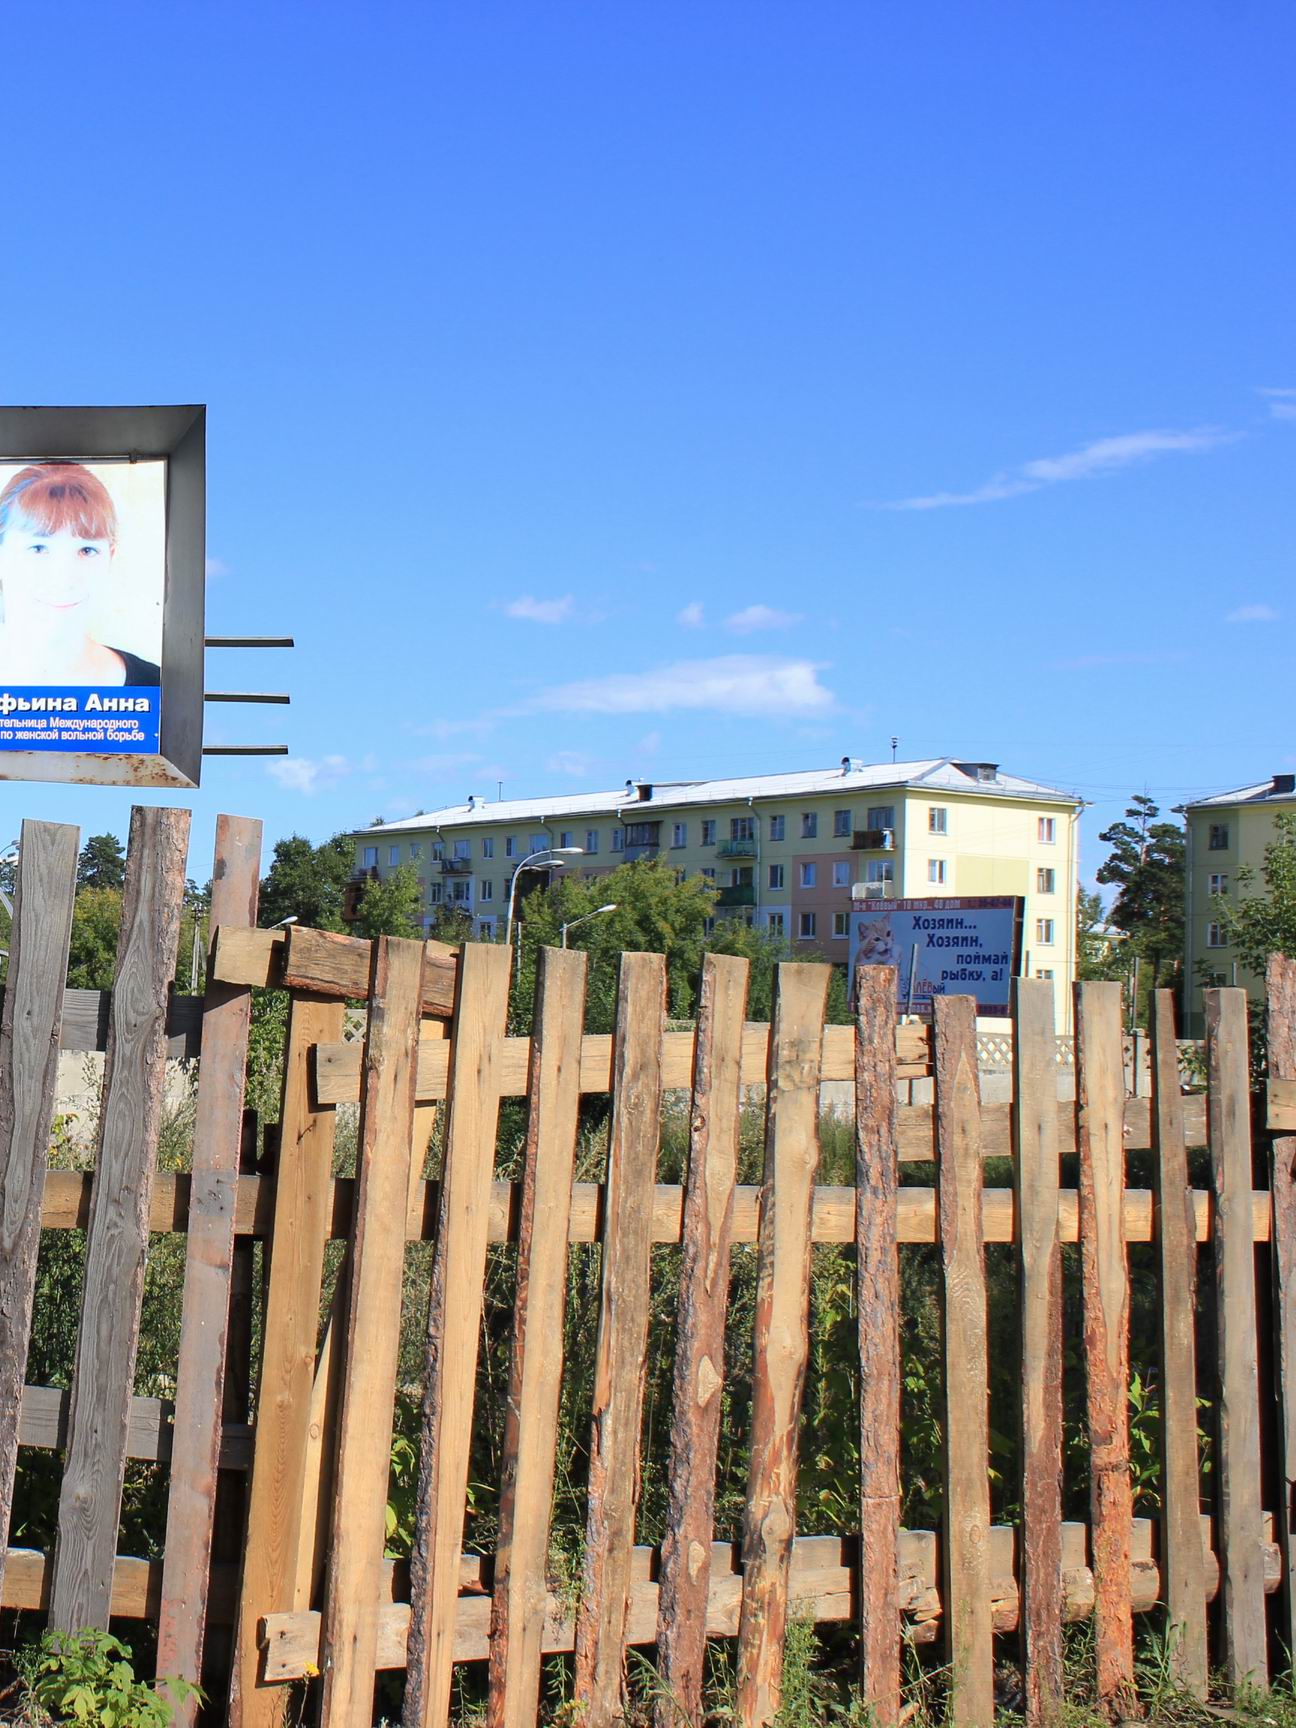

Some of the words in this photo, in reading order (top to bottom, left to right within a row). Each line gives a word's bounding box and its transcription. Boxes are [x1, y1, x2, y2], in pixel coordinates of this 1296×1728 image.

[85, 694, 151, 712] Анна
[50, 717, 139, 730] Международного
[0, 731, 13, 740] по
[15, 729, 58, 740] женской
[61, 729, 104, 740] вольной
[107, 730, 145, 742] борьбе
[912, 915, 977, 929] Хозяин...
[926, 933, 983, 948] Хозяин,
[956, 951, 1009, 965] поймай
[941, 968, 986, 982] рыбку,
[991, 967, 1003, 981] а!
